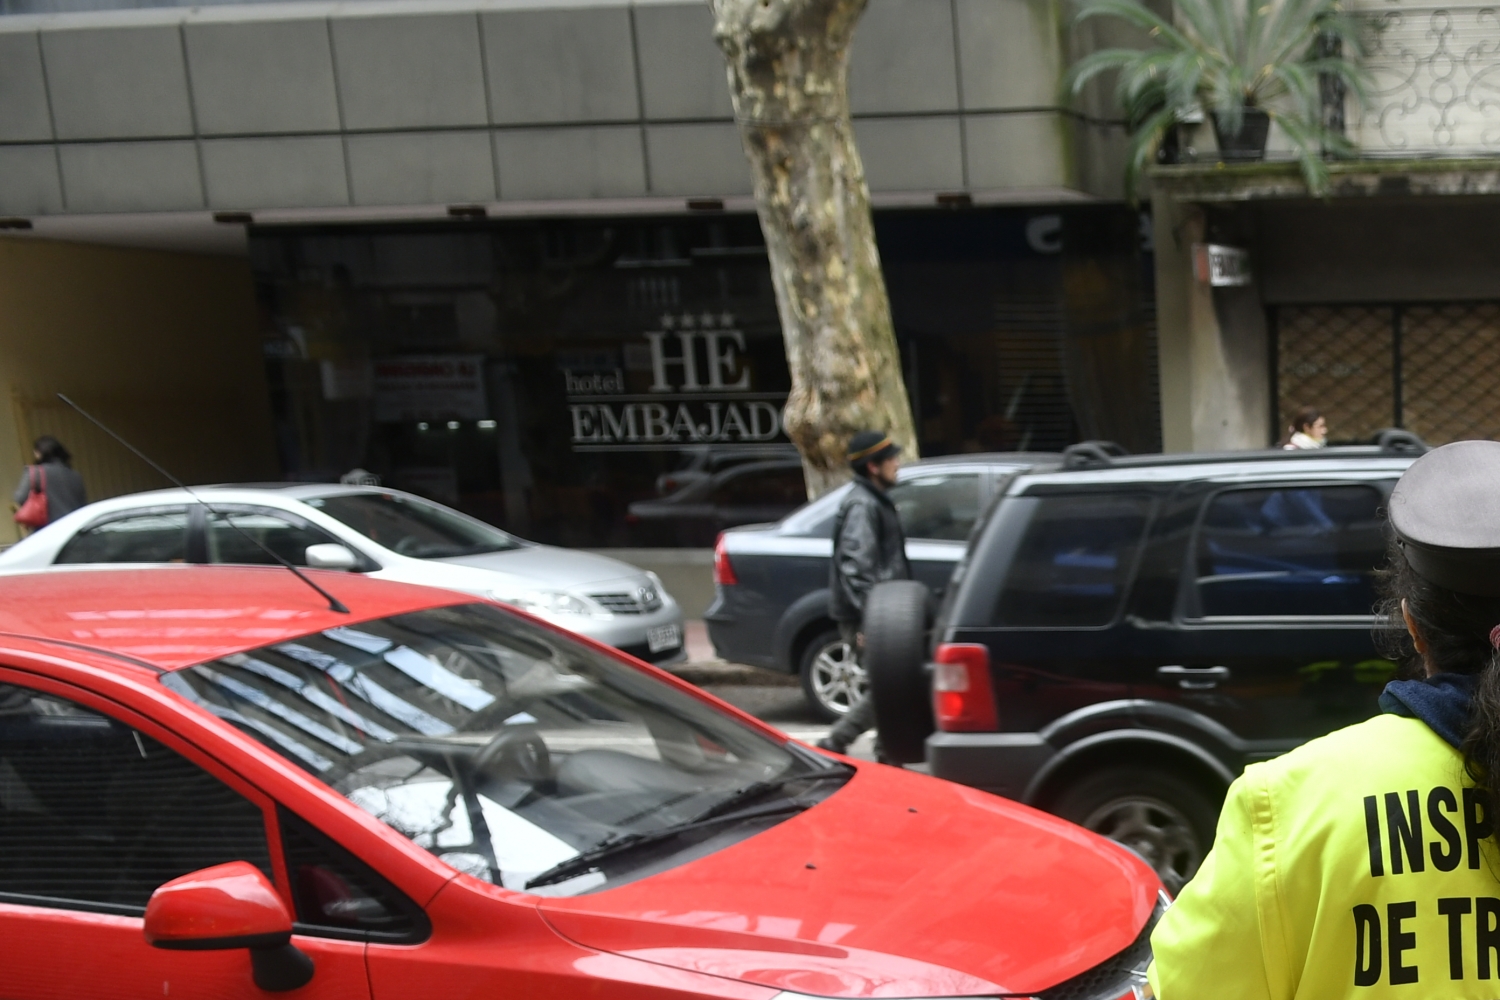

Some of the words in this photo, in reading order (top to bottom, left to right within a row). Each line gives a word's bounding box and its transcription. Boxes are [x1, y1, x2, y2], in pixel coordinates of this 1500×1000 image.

[564, 368, 625, 392] hotel
[644, 329, 750, 393] HE
[567, 401, 789, 443] EMBAJAD
[1352, 900, 1419, 987] DE
